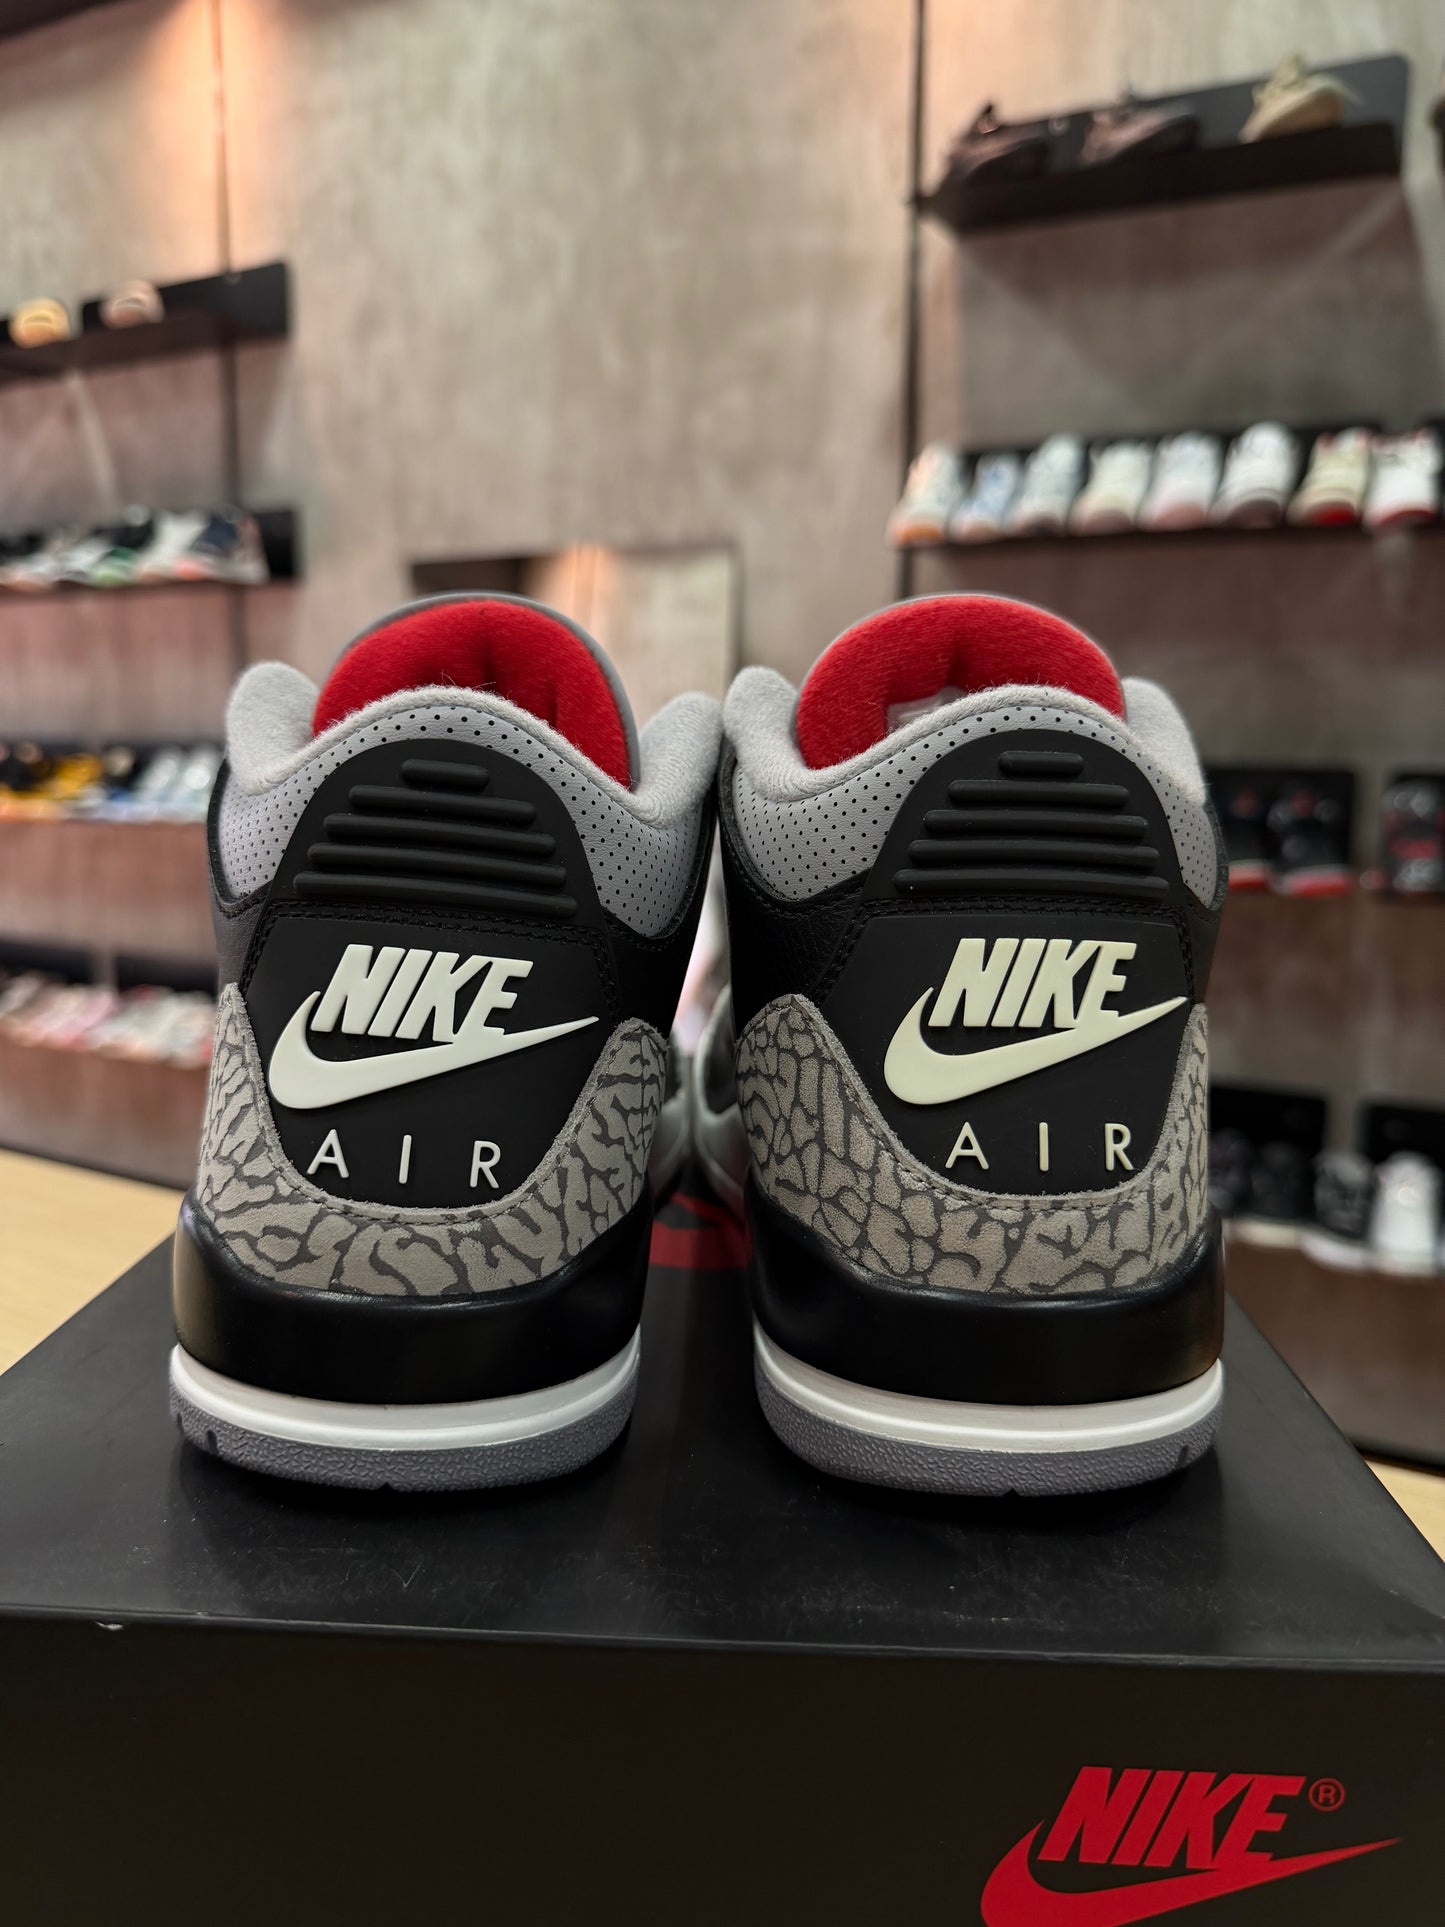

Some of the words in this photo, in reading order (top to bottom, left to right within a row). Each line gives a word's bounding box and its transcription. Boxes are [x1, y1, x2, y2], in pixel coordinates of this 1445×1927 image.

[310, 943, 533, 1043] NIKE
[928, 938, 1137, 1028] NIKE
[306, 1128, 501, 1189] AIR
[945, 1121, 1135, 1172] AIR
[1037, 1766, 1306, 1870] NIKE
